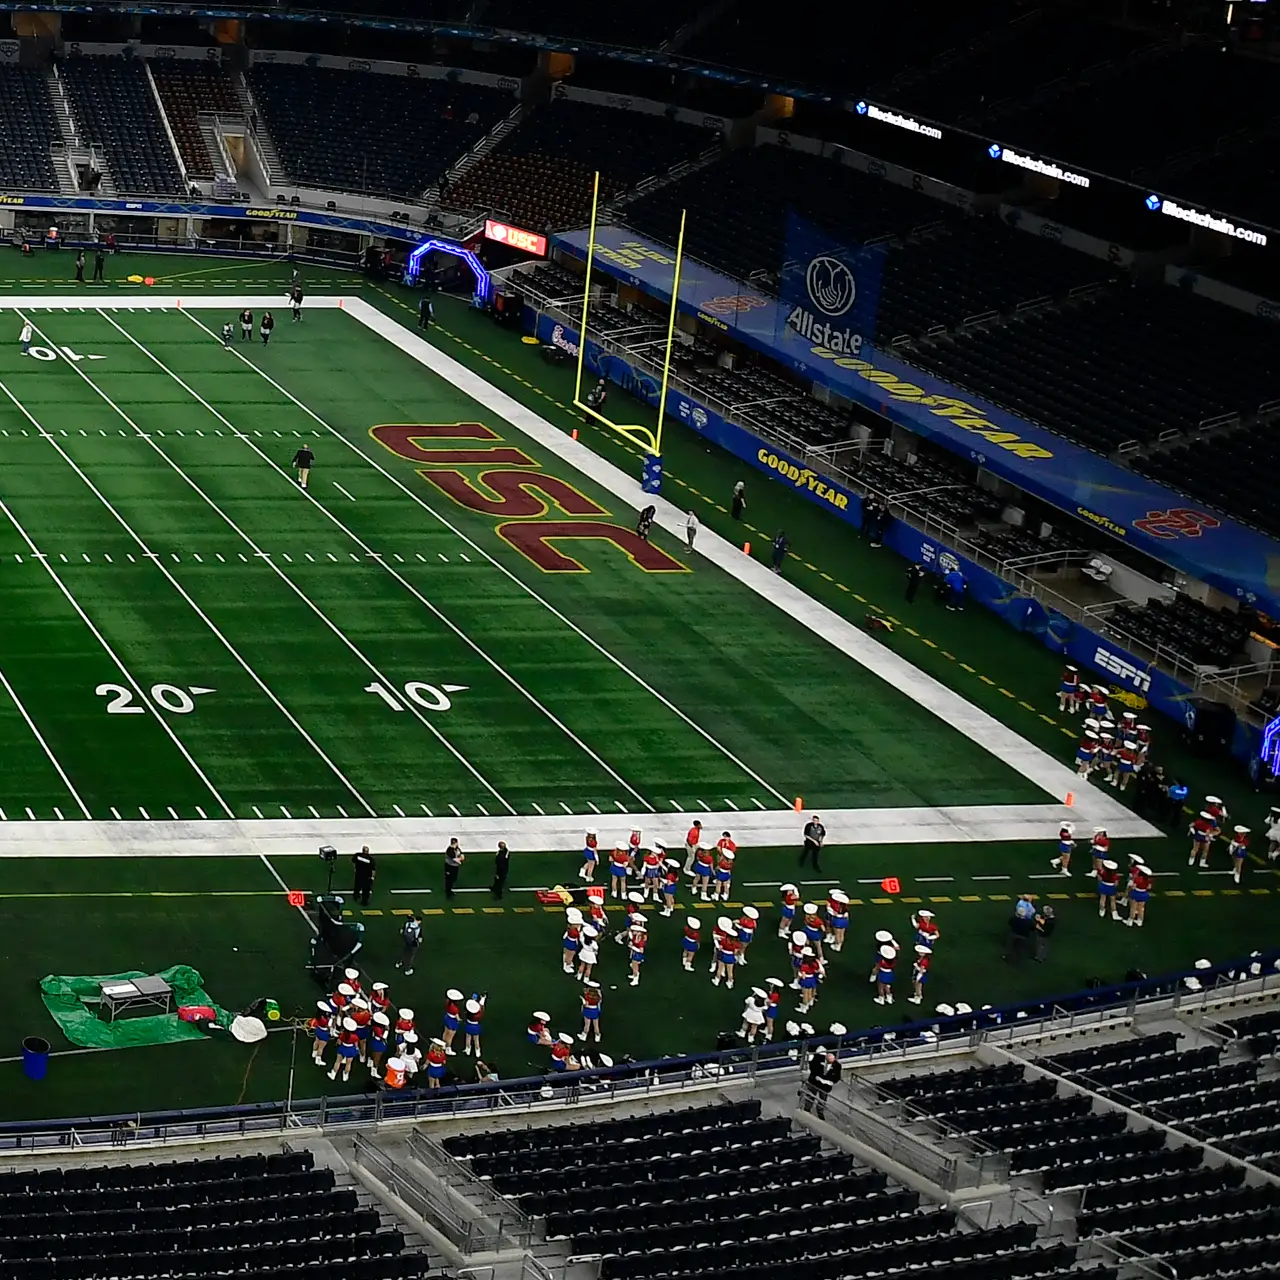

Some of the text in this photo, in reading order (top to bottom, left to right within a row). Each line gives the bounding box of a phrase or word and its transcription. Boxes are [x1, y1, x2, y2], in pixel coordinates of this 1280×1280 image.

[867, 105, 942, 139] Blockchain.com
[1001, 148, 1089, 188] Blockchain.com
[245, 209, 297, 219] GOODYEAR
[1162, 200, 1267, 246] Blockchain.com
[507, 228, 538, 251] USC
[787, 307, 863, 356] Allstate
[810, 346, 1054, 459] GOODYEAR
[758, 448, 849, 511] GOODYEAR
[368, 421, 694, 574] USC
[1077, 506, 1127, 535] GOODYEAR
[1094, 646, 1151, 693] ESPN
[95, 683, 197, 716] 20
[364, 681, 453, 715] 10
[291, 893, 303, 905] 20
[888, 880, 897, 891] G
